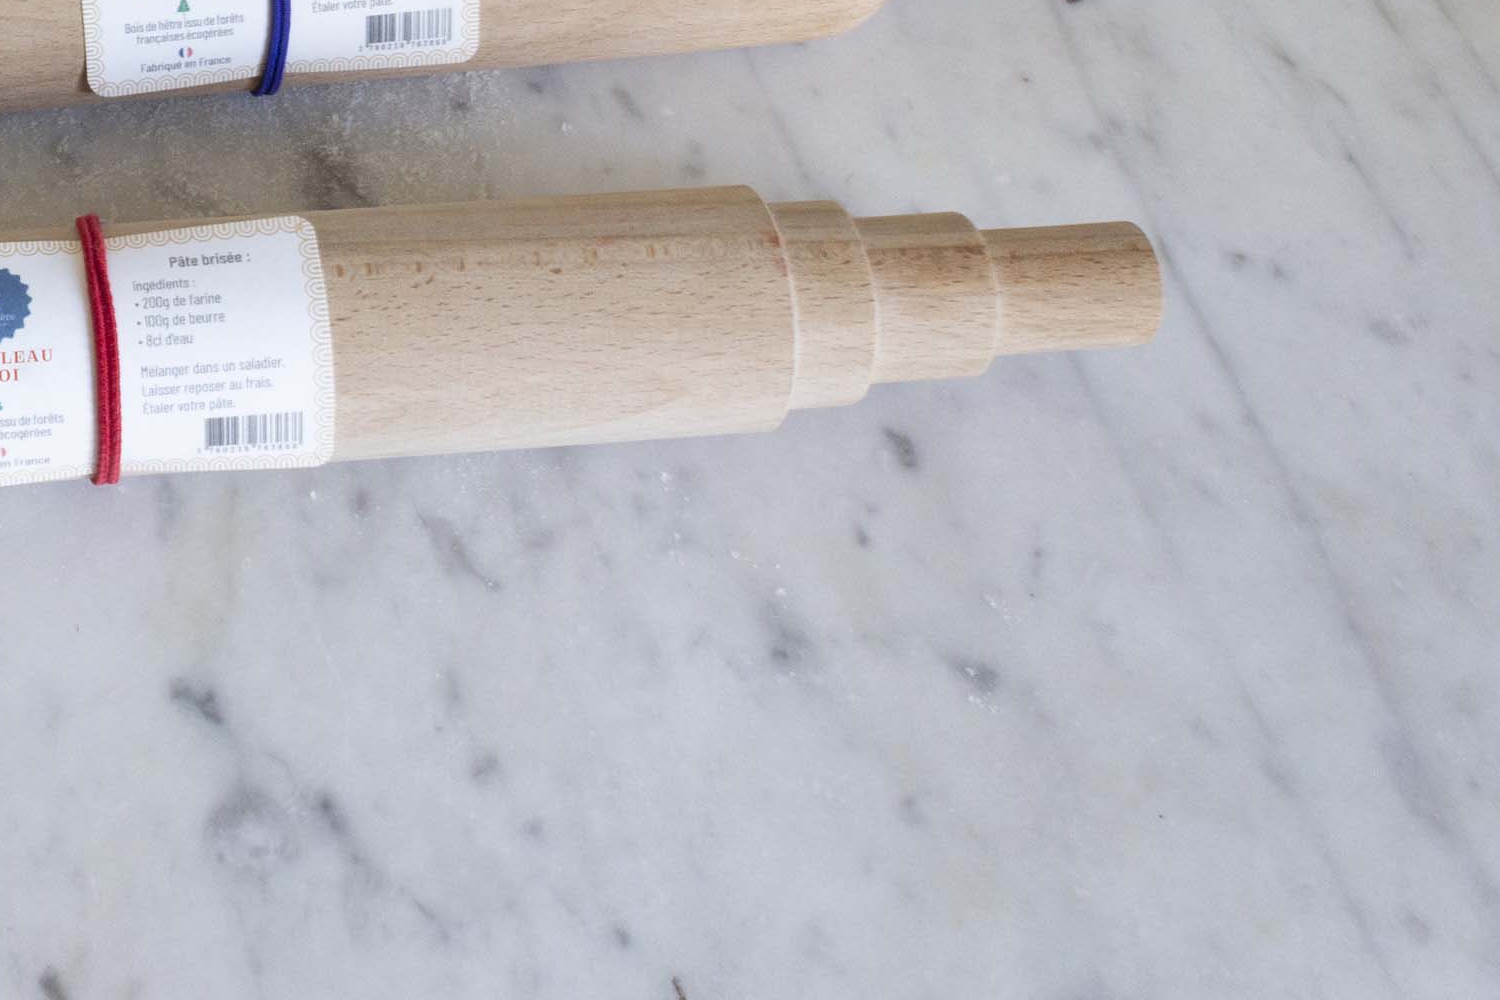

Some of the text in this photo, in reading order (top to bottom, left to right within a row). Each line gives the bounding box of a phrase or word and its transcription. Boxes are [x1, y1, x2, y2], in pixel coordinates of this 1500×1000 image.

[342, 0, 367, 10] votre
[124, 23, 144, 34] Bois
[145, 21, 157, 32] de
[184, 18, 202, 29] issu
[203, 15, 215, 26] de
[184, 58, 197, 69] en
[199, 56, 232, 67] France
[169, 255, 198, 268] Pâte
[201, 252, 242, 266] brisée
[142, 293, 222, 310] 200g de farine
[144, 312, 226, 328] 100g de beurre
[193, 362, 219, 375] dans
[222, 361, 235, 372] un
[239, 357, 286, 371] saladier.
[141, 376, 273, 397] Laisser reposer au frais.
[178, 400, 205, 412] votre
[18, 415, 31, 426] de
[33, 412, 65, 425] forêts
[14, 456, 51, 466] France
